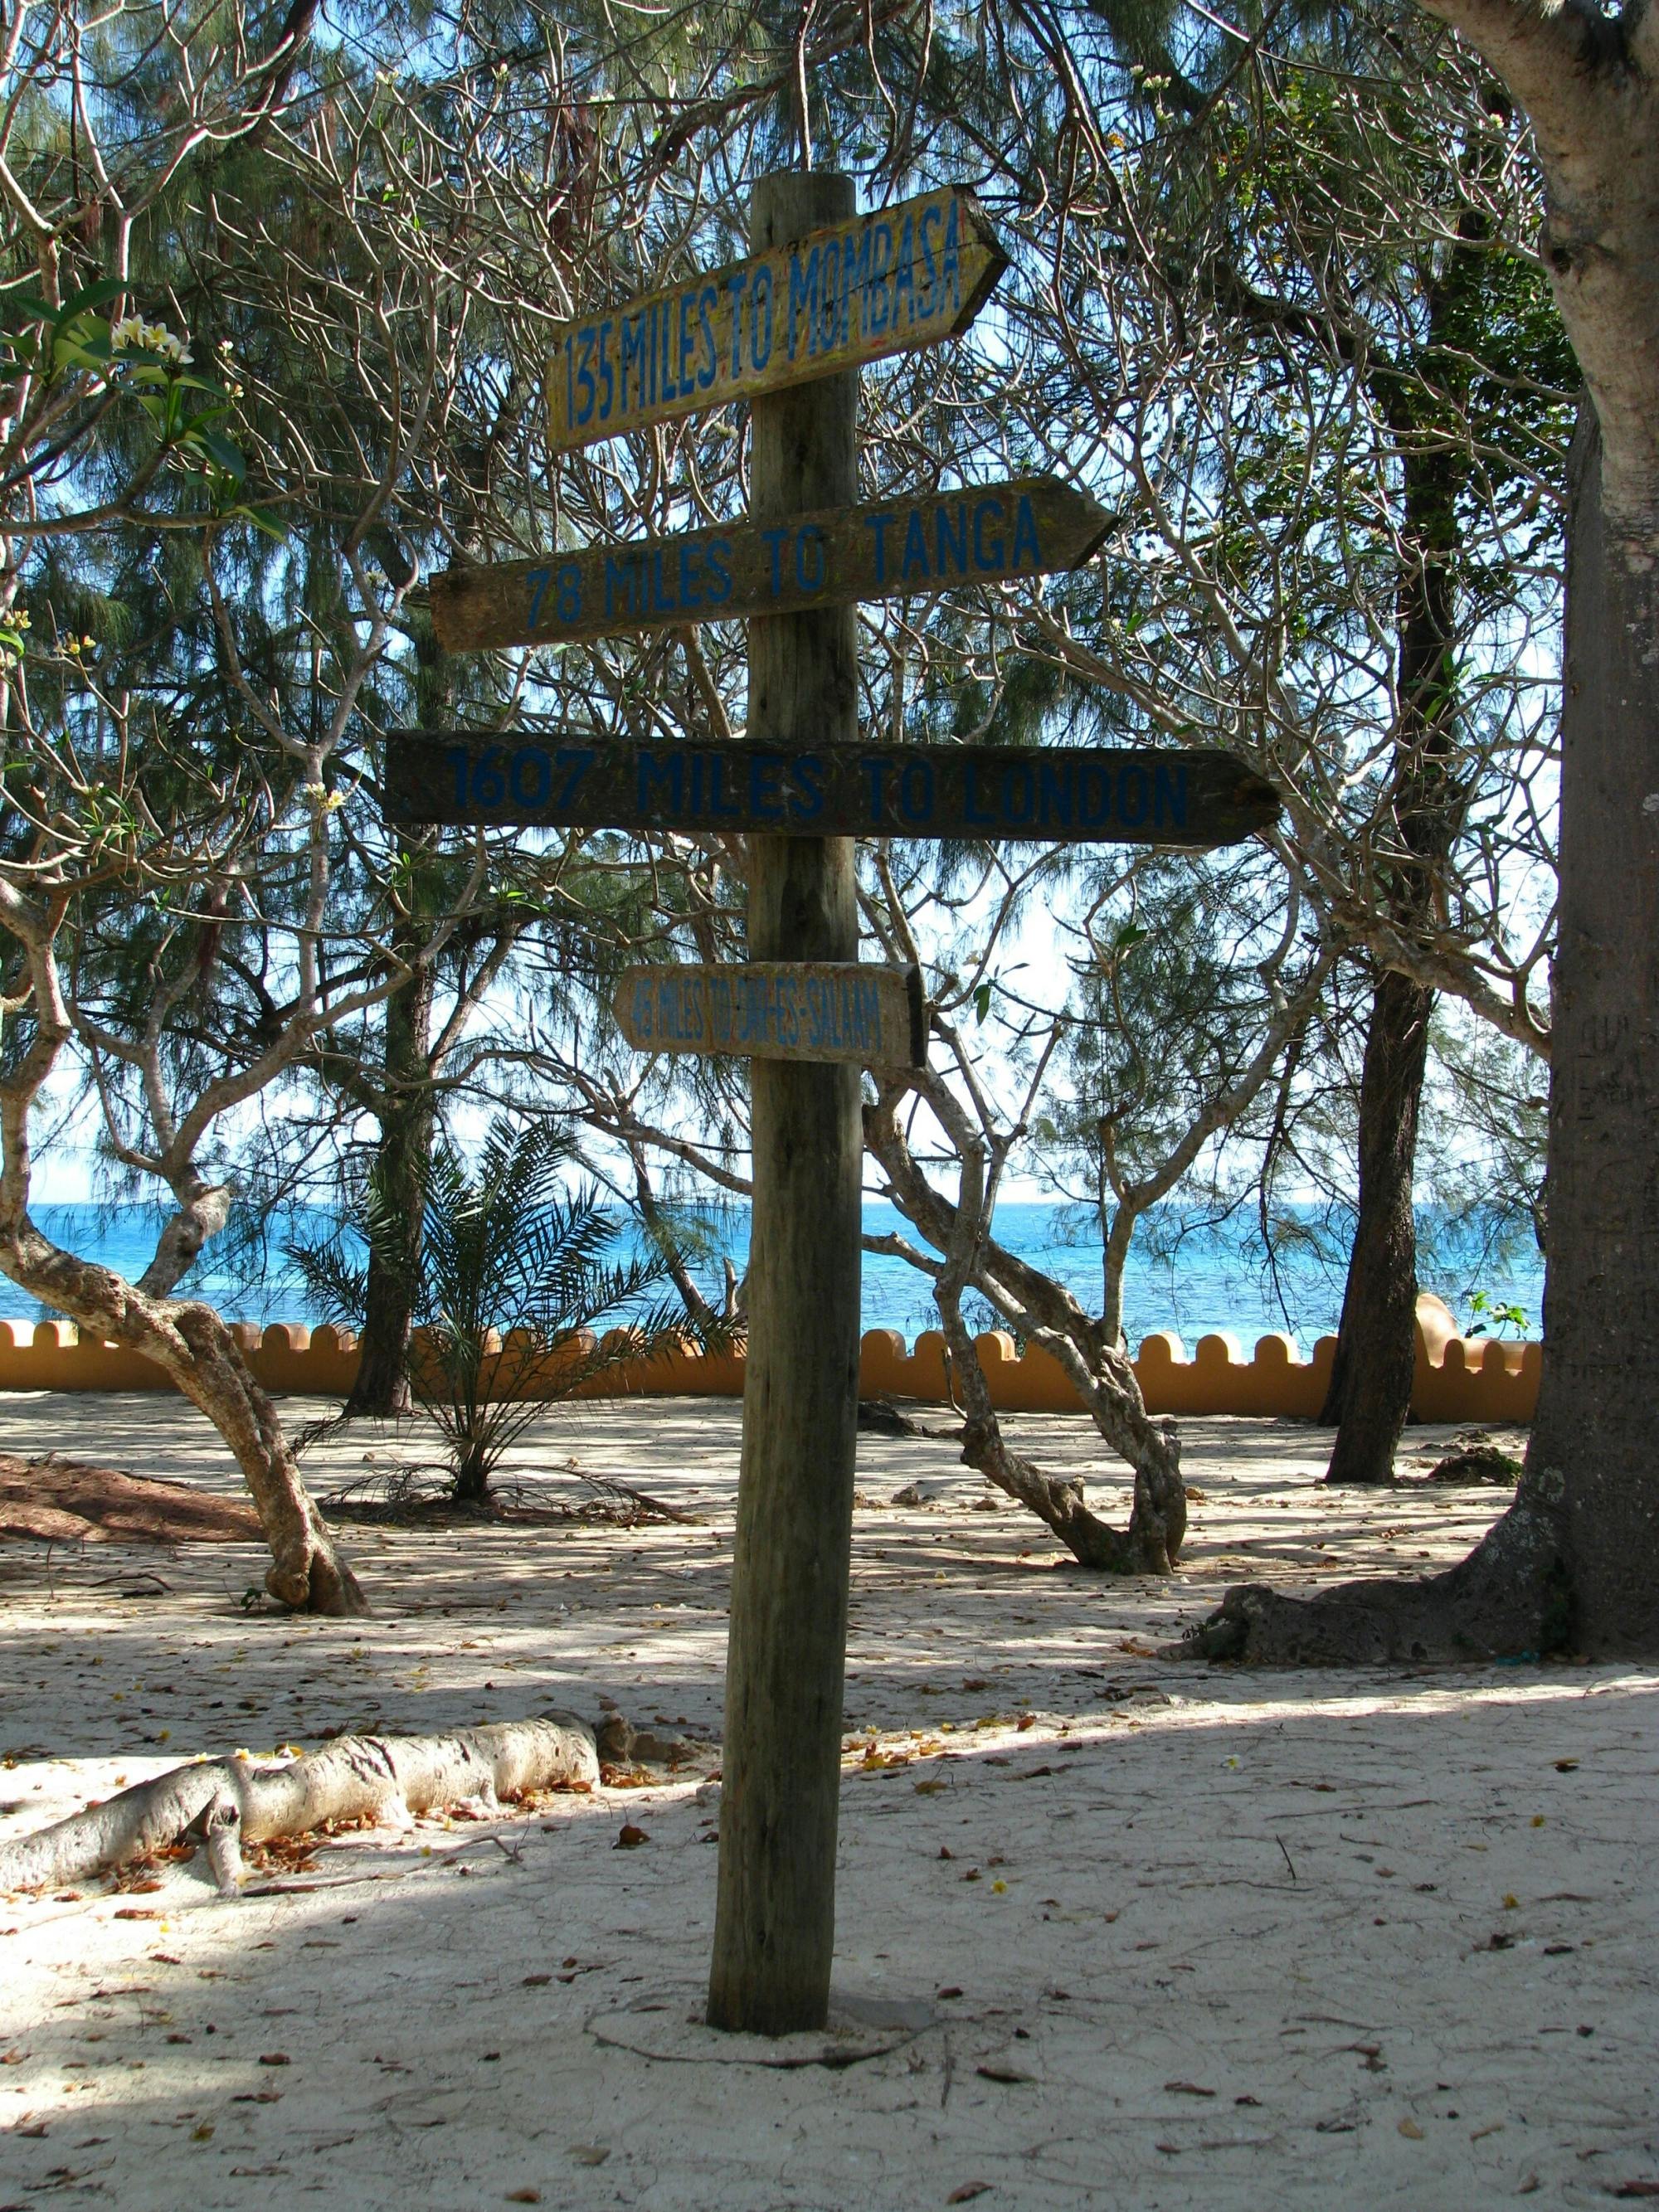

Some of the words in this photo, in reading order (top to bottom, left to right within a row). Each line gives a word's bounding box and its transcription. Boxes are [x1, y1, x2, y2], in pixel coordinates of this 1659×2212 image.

[564, 321, 614, 430] 135
[620, 284, 718, 413] MILES
[727, 264, 772, 380] TO
[788, 199, 961, 362] MOMBASA
[526, 563, 583, 629] 78
[604, 538, 734, 618] MILES
[761, 525, 825, 596] TO
[865, 493, 1043, 584] TANGA
[447, 746, 594, 809] 1607
[638, 751, 825, 819] MILES
[861, 758, 934, 822] TO
[965, 761, 1189, 829] LONDON
[659, 978, 703, 1040] MILES
[709, 978, 731, 1042] TO
